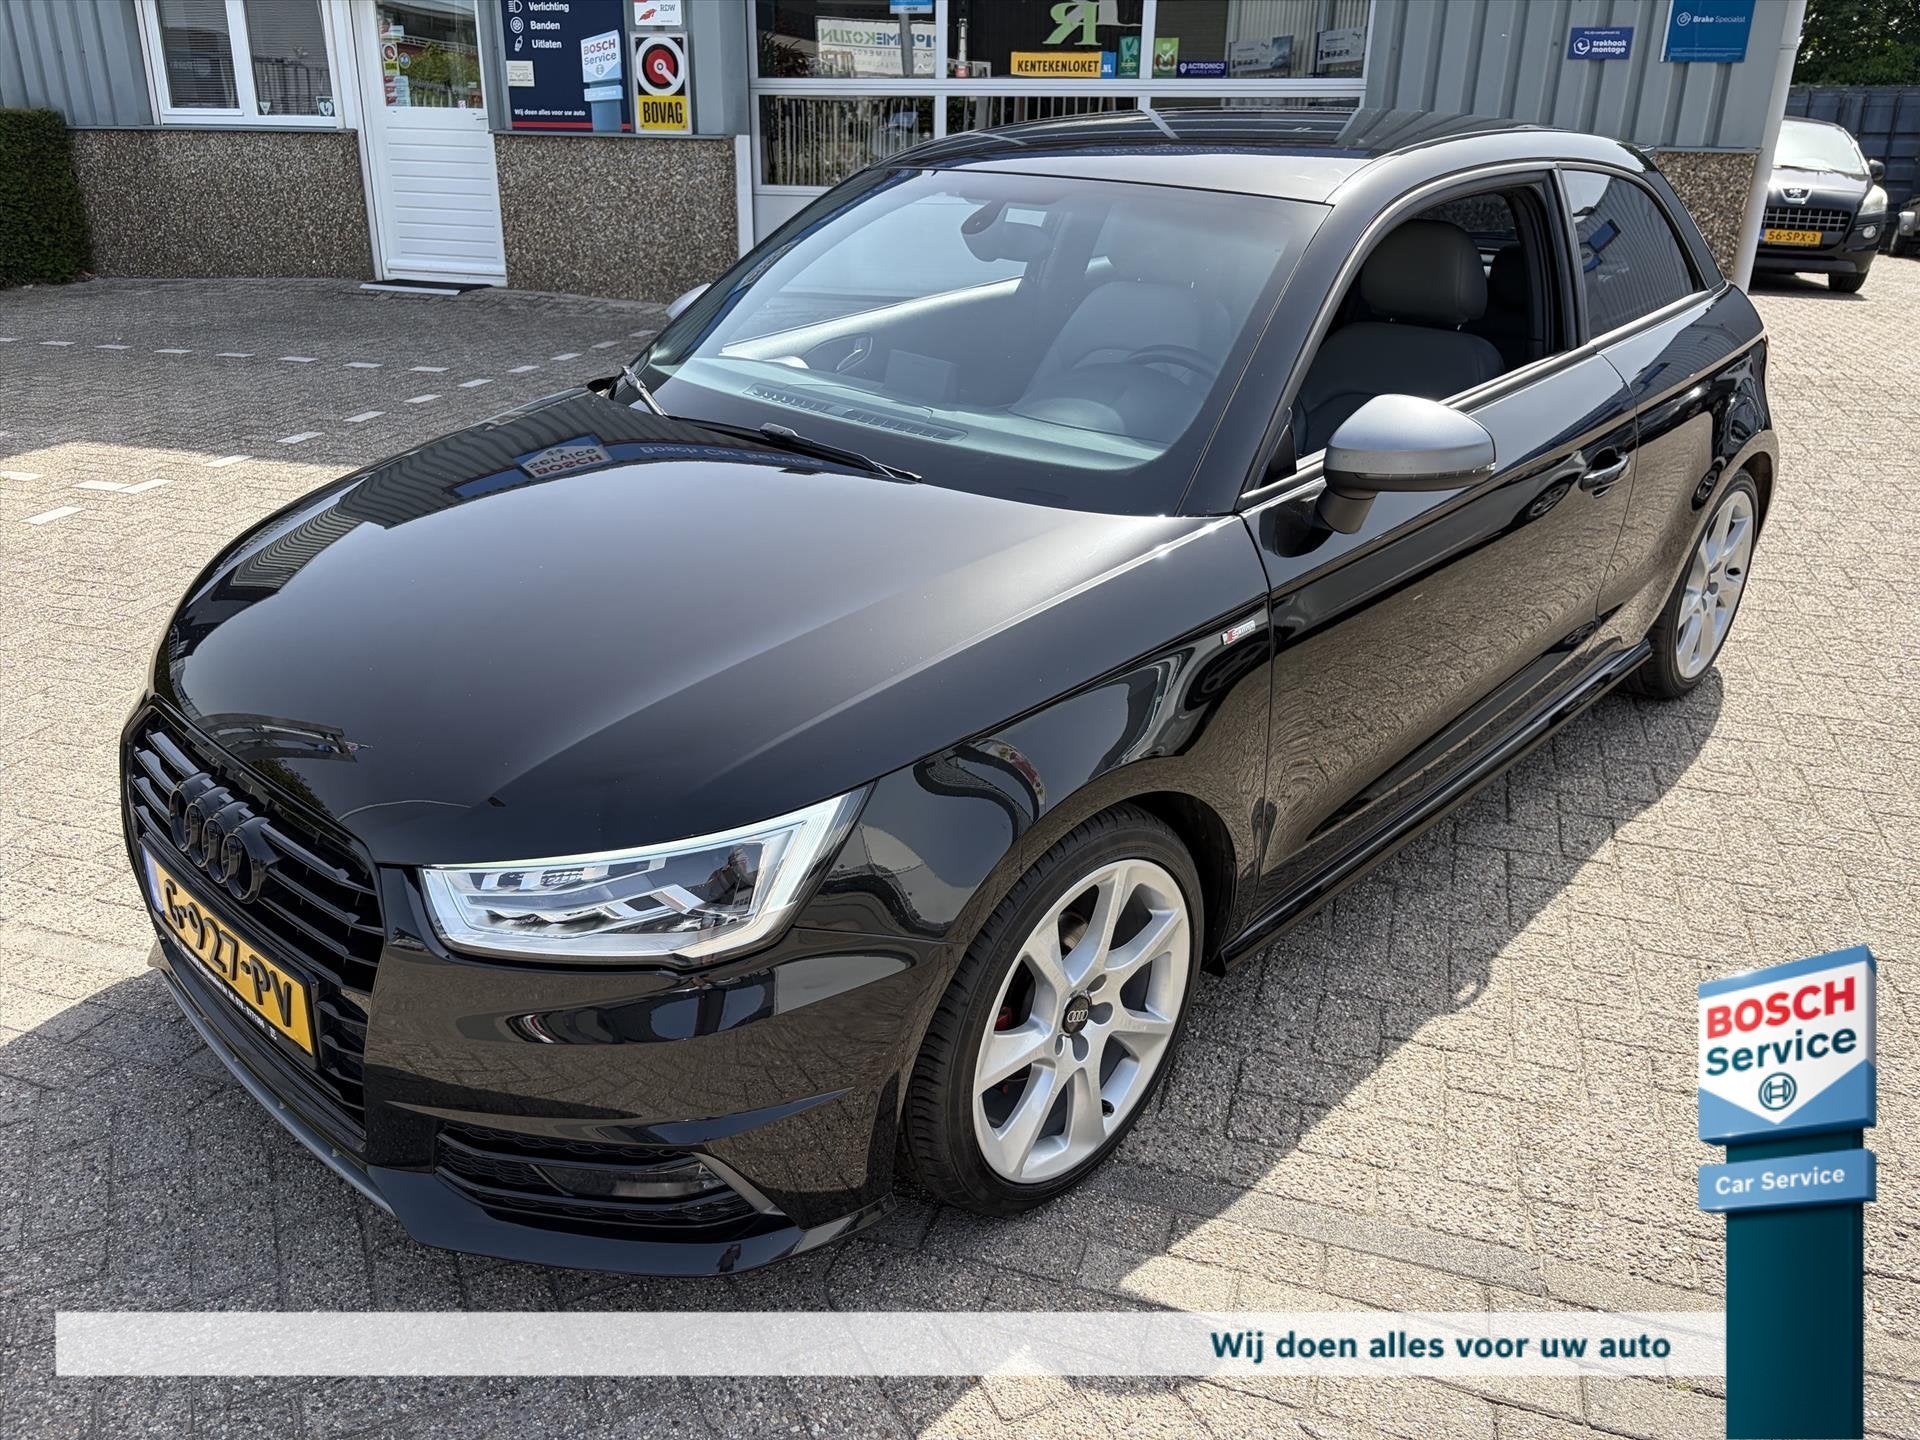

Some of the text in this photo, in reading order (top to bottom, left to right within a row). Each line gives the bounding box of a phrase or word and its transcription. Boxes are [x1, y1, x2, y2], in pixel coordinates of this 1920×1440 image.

[528, 1, 570, 13] Verlichting
[530, 20, 561, 31] Banden
[1692, 15, 1746, 24] Brake Specialist
[531, 39, 562, 50] Uitlaten
[583, 38, 616, 55] BOSCH
[1592, 46, 1626, 55] montage
[583, 51, 617, 66] Service
[1017, 59, 1099, 73] KENTEKENLOKET
[1187, 61, 1225, 71] ACTRONICS
[514, 108, 524, 116] Wij
[643, 101, 683, 124] BOVAG
[1767, 230, 1818, 243] 56-SPX-3
[164, 878, 292, 1028] G-927-PV
